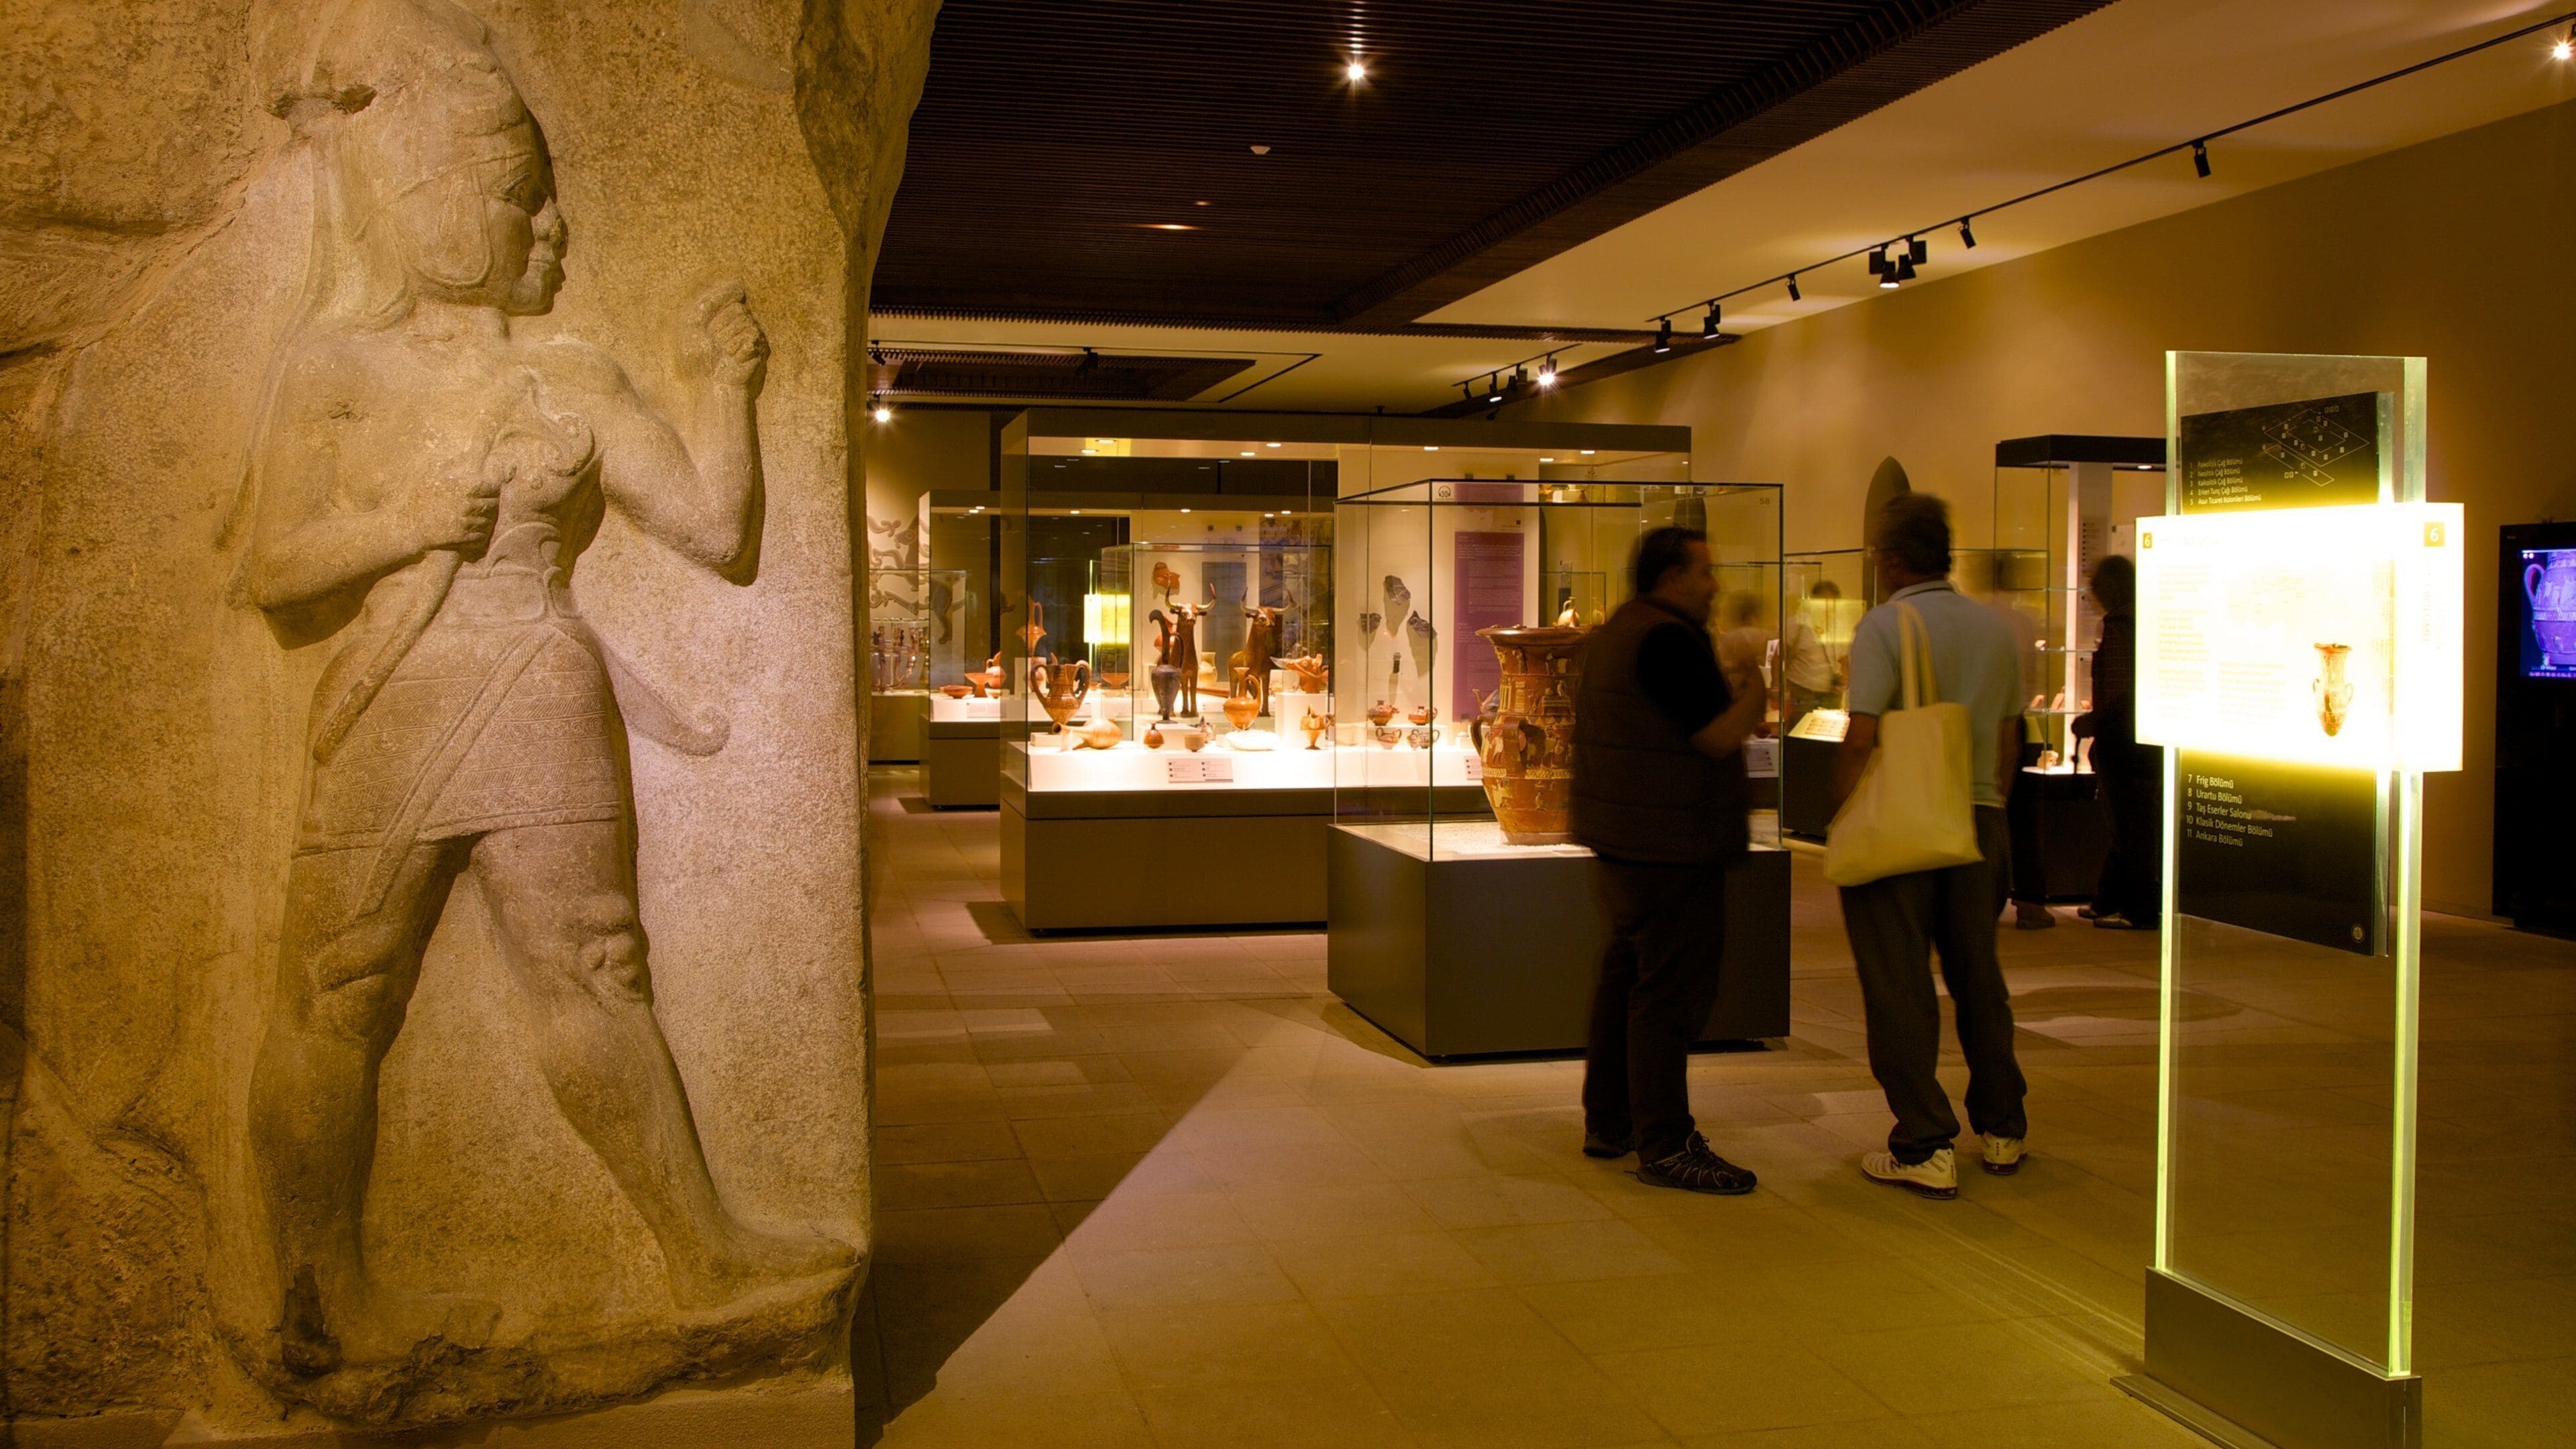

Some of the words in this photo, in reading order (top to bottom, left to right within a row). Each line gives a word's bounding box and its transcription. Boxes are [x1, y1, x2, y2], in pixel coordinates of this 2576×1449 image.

[2144, 535, 2151, 547] 6
[2430, 527, 2439, 542] 6
[2188, 774, 2192, 783] 7
[2196, 775, 2209, 788] Frig
[2209, 777, 2234, 789] Bölümü
[2188, 788, 2192, 797] 8
[2196, 790, 2216, 800] Urartu
[2218, 792, 2242, 804] Bölümü
[2188, 802, 2192, 810] 9
[2196, 802, 2206, 815] Taş
[2207, 804, 2228, 816] Eserler
[2229, 807, 2251, 820] Salonu
[2186, 815, 2194, 824] 10
[2196, 816, 2214, 828] Klasik
[2215, 819, 2247, 833] Dönemler
[2247, 824, 2273, 838] Bölümü
[2187, 828, 2192, 837] 11
[2196, 830, 2217, 842] Ankara
[2218, 834, 2243, 847] Bölümü
